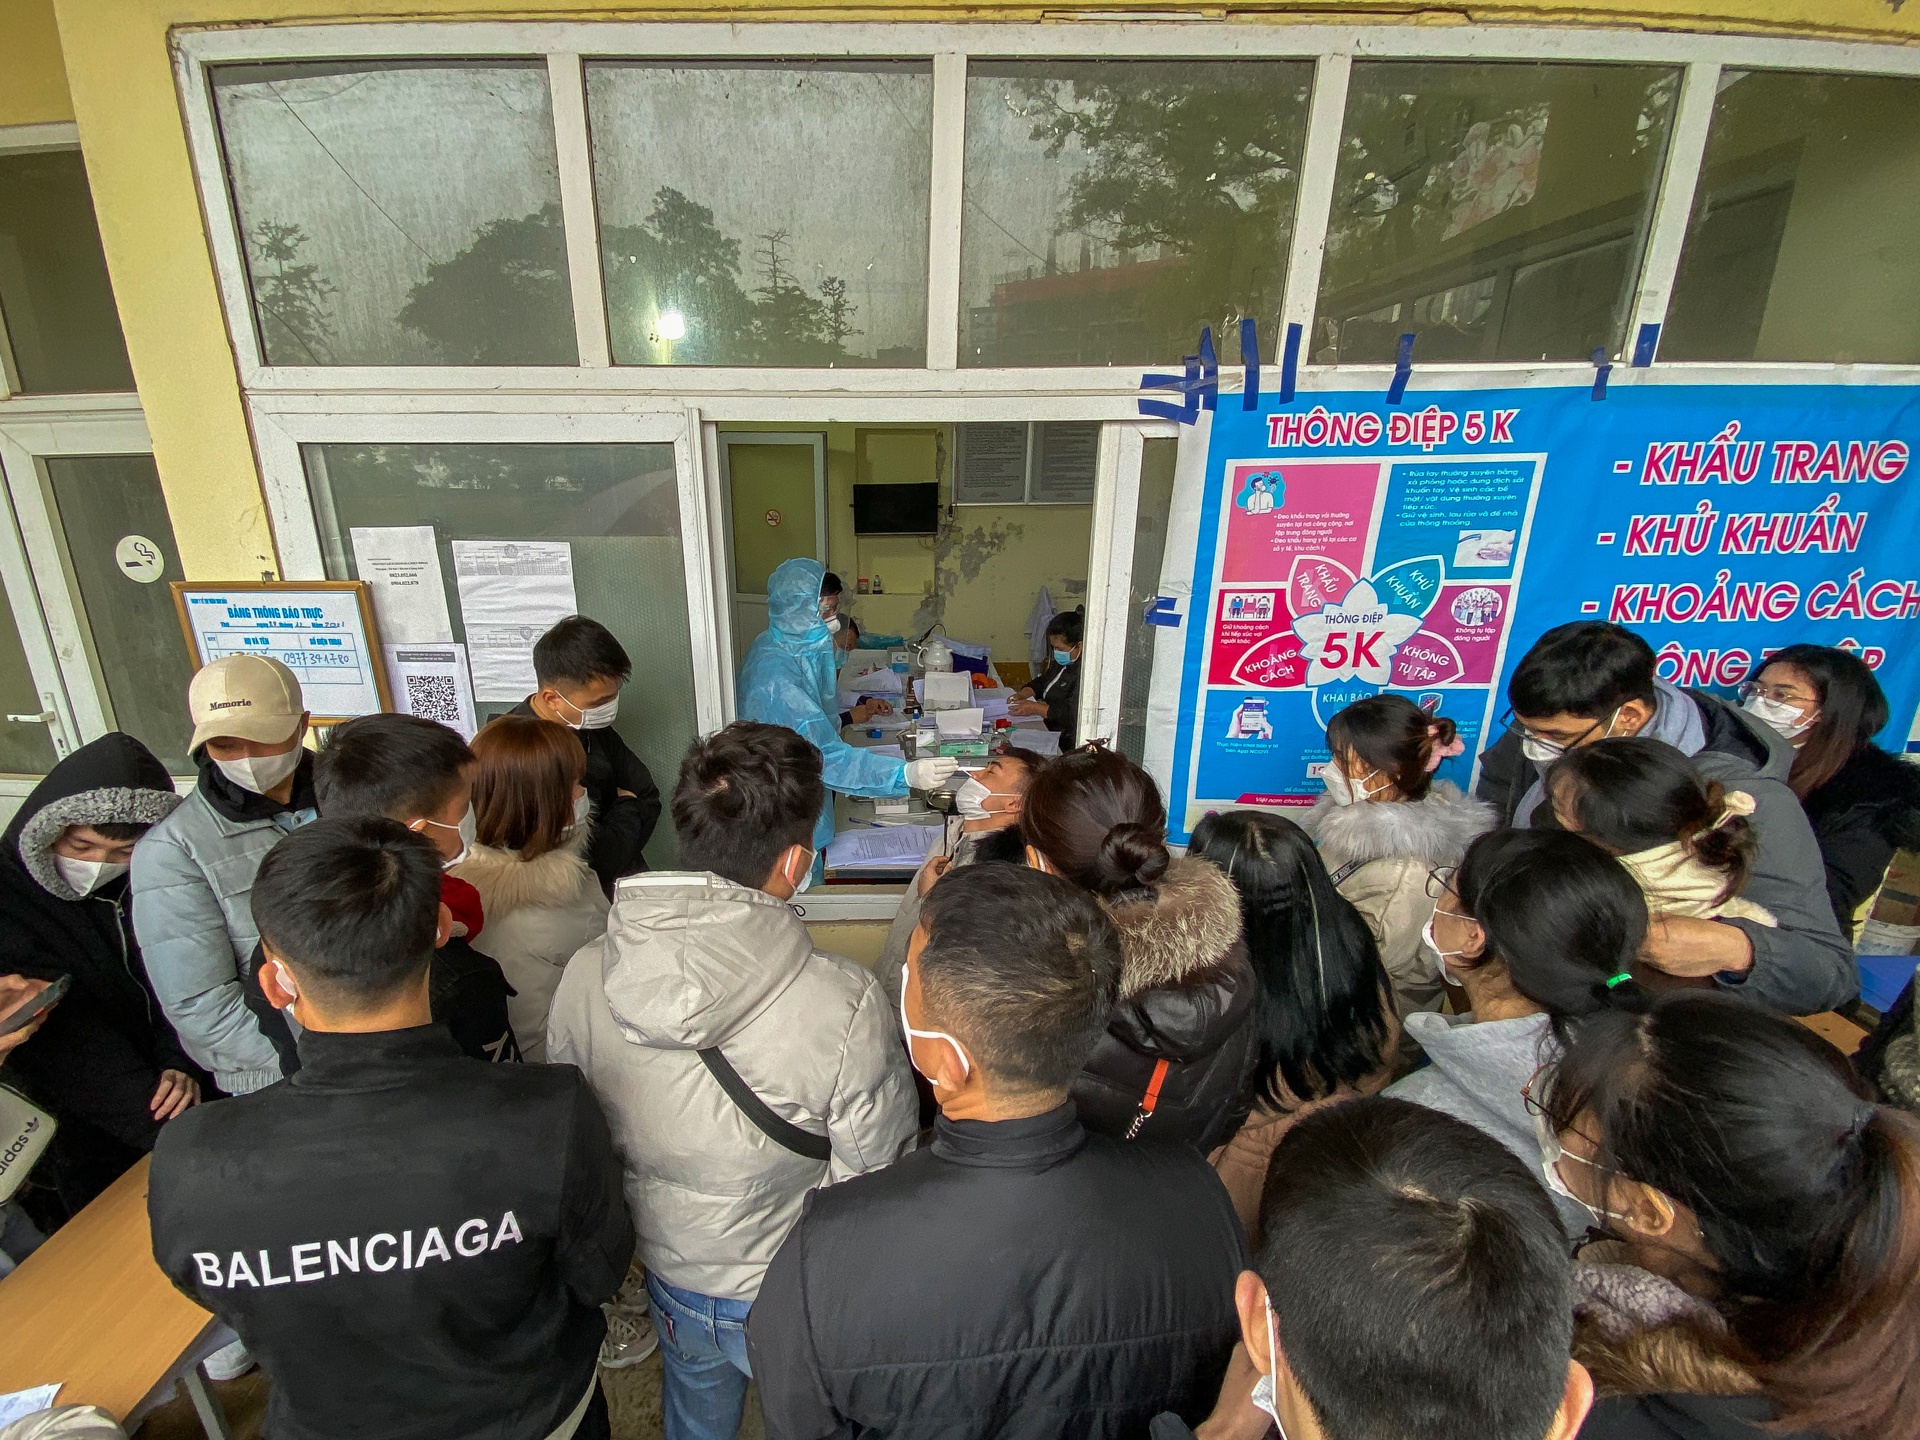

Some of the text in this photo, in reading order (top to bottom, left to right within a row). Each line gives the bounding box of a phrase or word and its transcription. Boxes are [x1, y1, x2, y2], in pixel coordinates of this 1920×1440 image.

[1266, 405, 1520, 451] THÔNG ĐIỆP 5 K
[1640, 420, 1909, 485] KHẨU TRANG
[1623, 493, 1868, 556] KHỬ KHUẨN
[1297, 572, 1321, 608] TRANG
[1315, 564, 1337, 593] KHẨU
[1385, 575, 1420, 610] KHUẨN
[1409, 569, 1435, 590] KHỬ
[1609, 567, 1920, 623] KHOẢNG CÁCH
[227, 604, 323, 622] BẢNG THÔNG BÁO TRỰC
[1325, 612, 1383, 625] THÔNG ĐIỆP
[1244, 649, 1297, 674] KHOẢNG
[1320, 631, 1385, 669] 5K
[1402, 645, 1450, 666] KHÔNG
[1654, 641, 1752, 687] ÔNG
[1259, 665, 1295, 683] CÁCH
[1398, 662, 1437, 680] TỤ TẬP
[209, 698, 252, 711] Memorie
[1322, 693, 1347, 703] KHAI
[193, 1210, 524, 1288] BALENCIAGA
